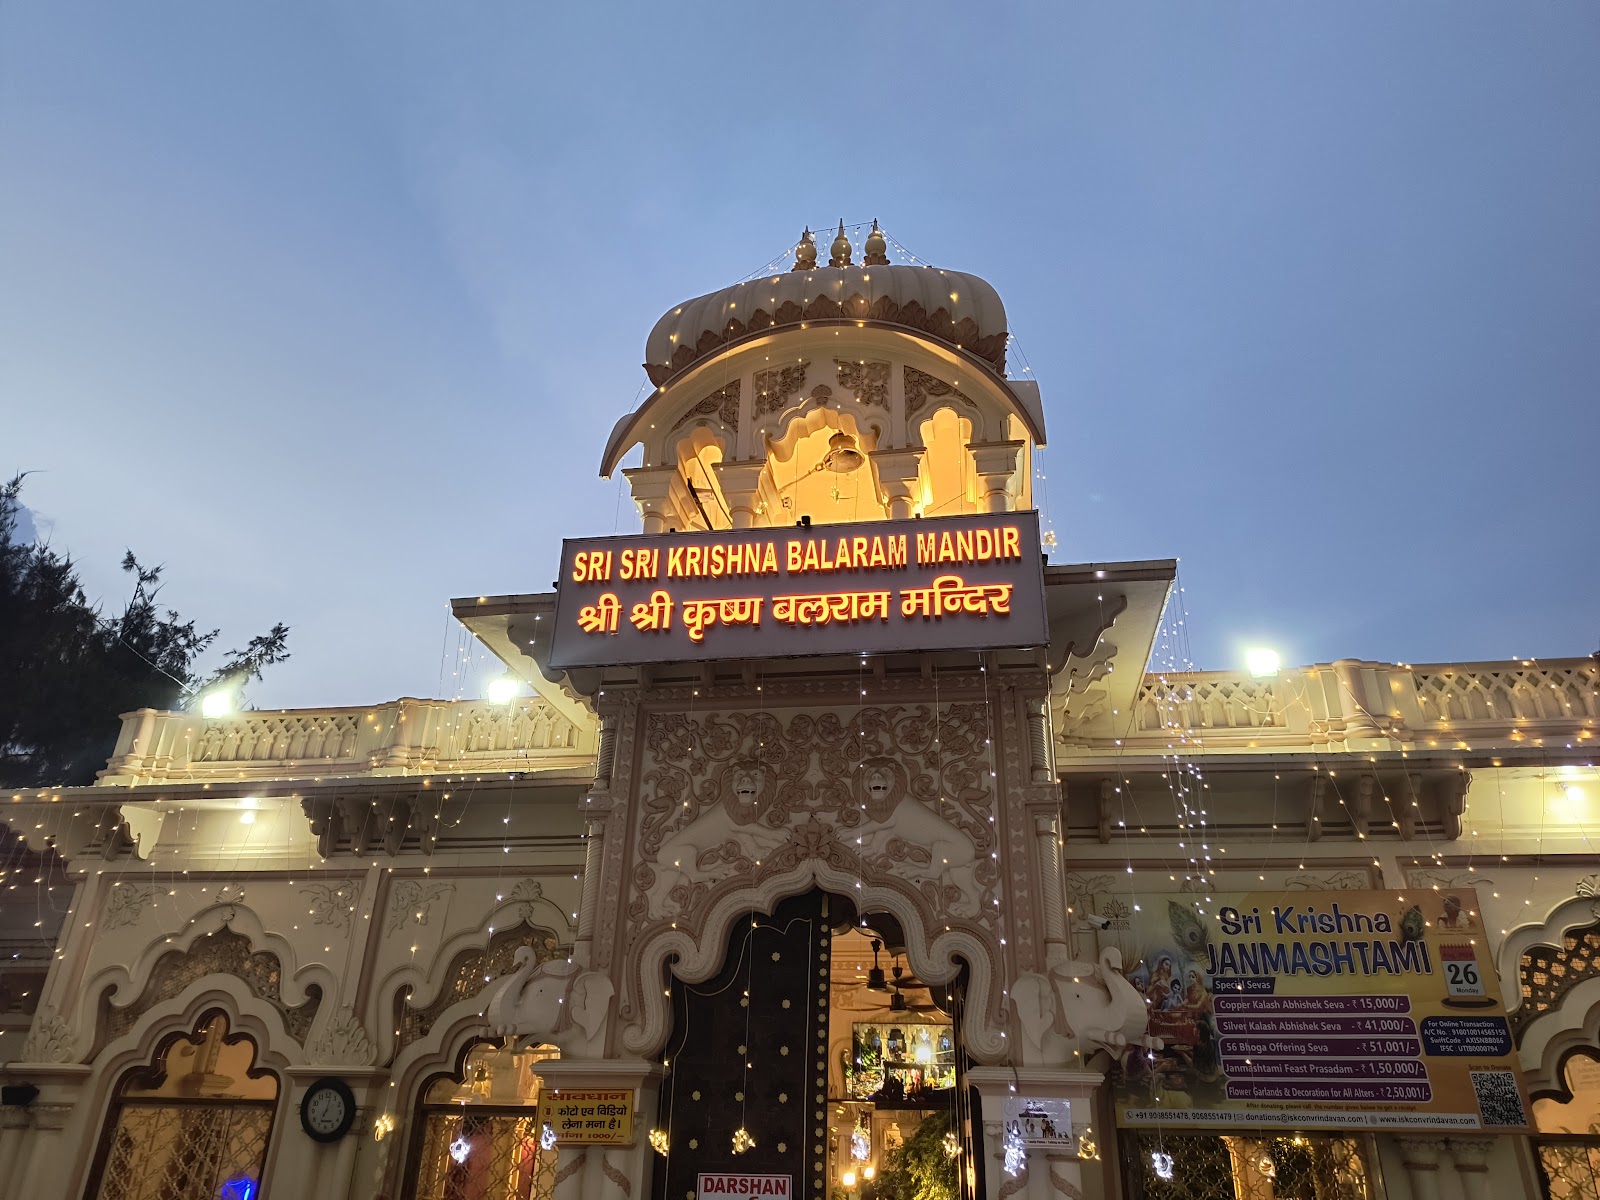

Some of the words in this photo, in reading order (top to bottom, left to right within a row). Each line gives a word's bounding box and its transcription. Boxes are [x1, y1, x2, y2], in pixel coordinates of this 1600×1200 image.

[573, 551, 612, 582] SRI
[620, 549, 659, 580] SRI
[667, 542, 778, 577] KRISHNA
[787, 534, 907, 573] BALARAM
[916, 526, 1021, 566] MANDIR
[577, 593, 622, 633] श्री
[629, 590, 674, 631] श्री
[683, 597, 764, 642] कृष्ण
[772, 591, 892, 625] बलराम
[900, 575, 1013, 618] मन्दिर
[1219, 906, 1262, 935] Sri
[1273, 903, 1392, 934] Krishna
[1206, 940, 1432, 976] JANMASHTAMI
[1448, 964, 1478, 984] 26
[1215, 980, 1245, 991] Special
[1247, 981, 1270, 989] Sevas
[1220, 1000, 1250, 1011] Copper
[1252, 1000, 1280, 1009] Kalash
[1282, 1000, 1322, 1009] Abhishek
[1324, 1000, 1344, 1009] Seva
[1360, 998, 1404, 1010] 15,000/-
[1223, 1022, 1247, 1030] Silver
[1249, 1022, 1277, 1030] Kalash
[1279, 1022, 1319, 1030] Abhishek
[1321, 1022, 1341, 1030] Seva
[1365, 1020, 1409, 1032] 41,000/-
[1226, 1043, 1237, 1052] 56
[1239, 1043, 1267, 1054] Bhoga
[1269, 1043, 1306, 1054] Offering
[1307, 1043, 1329, 1052] Seva
[1370, 1041, 1415, 1053] 51,001/-
[1225, 1063, 1282, 1073] Janmashtami
[1285, 1064, 1308, 1073] Feast
[1309, 1064, 1353, 1073] Prasadam
[1369, 1063, 1424, 1075] 1,50,000/-
[1228, 1087, 1252, 1096] Flower
[1253, 1087, 1282, 1096] Garlands
[1284, 1088, 1291, 1096] &
[1292, 1088, 1330, 1097] Decoration
[1330, 1088, 1341, 1097] for
[1343, 1088, 1352, 1097] All
[1354, 1088, 1374, 1097] Alters
[1386, 1087, 1429, 1099] 2,50,001/-
[558, 1105, 578, 1116] फोटो
[597, 1104, 627, 1116] विडियो
[562, 1118, 583, 1129] लेना
[586, 1121, 606, 1129] मना
[1245, 1114, 1364, 1123] donations@iskconvrindavan.com
[1379, 1116, 1475, 1124] www.iskconvrindavan.com
[704, 1177, 786, 1195] DARSHAN
